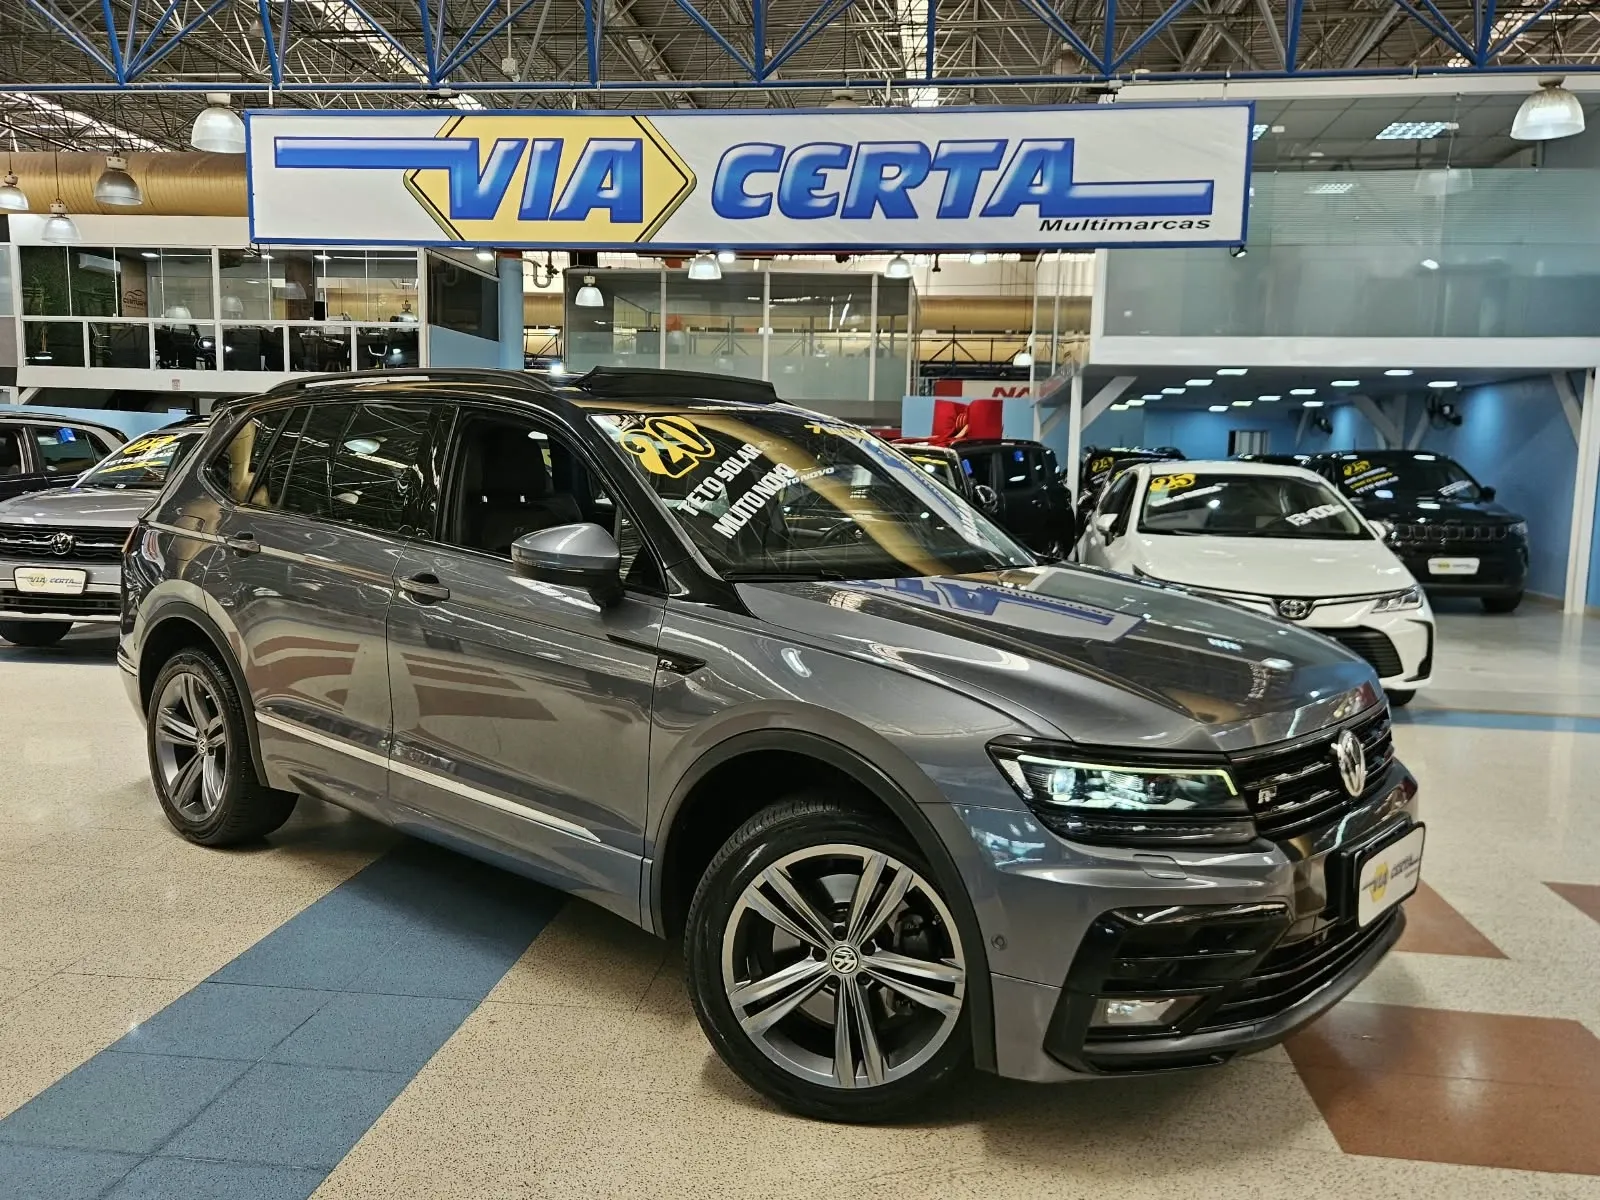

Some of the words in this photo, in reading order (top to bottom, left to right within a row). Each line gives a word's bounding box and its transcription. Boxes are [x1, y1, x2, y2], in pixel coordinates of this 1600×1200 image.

[711, 137, 1214, 219] CERTA
[1039, 219, 1212, 232] Multimarcas
[620, 416, 715, 478] 20
[677, 476, 724, 516] TETO
[714, 443, 763, 483] SOLAR
[712, 491, 766, 539] MUITO
[751, 463, 798, 500] NOVO
[1150, 473, 1196, 492] 25
